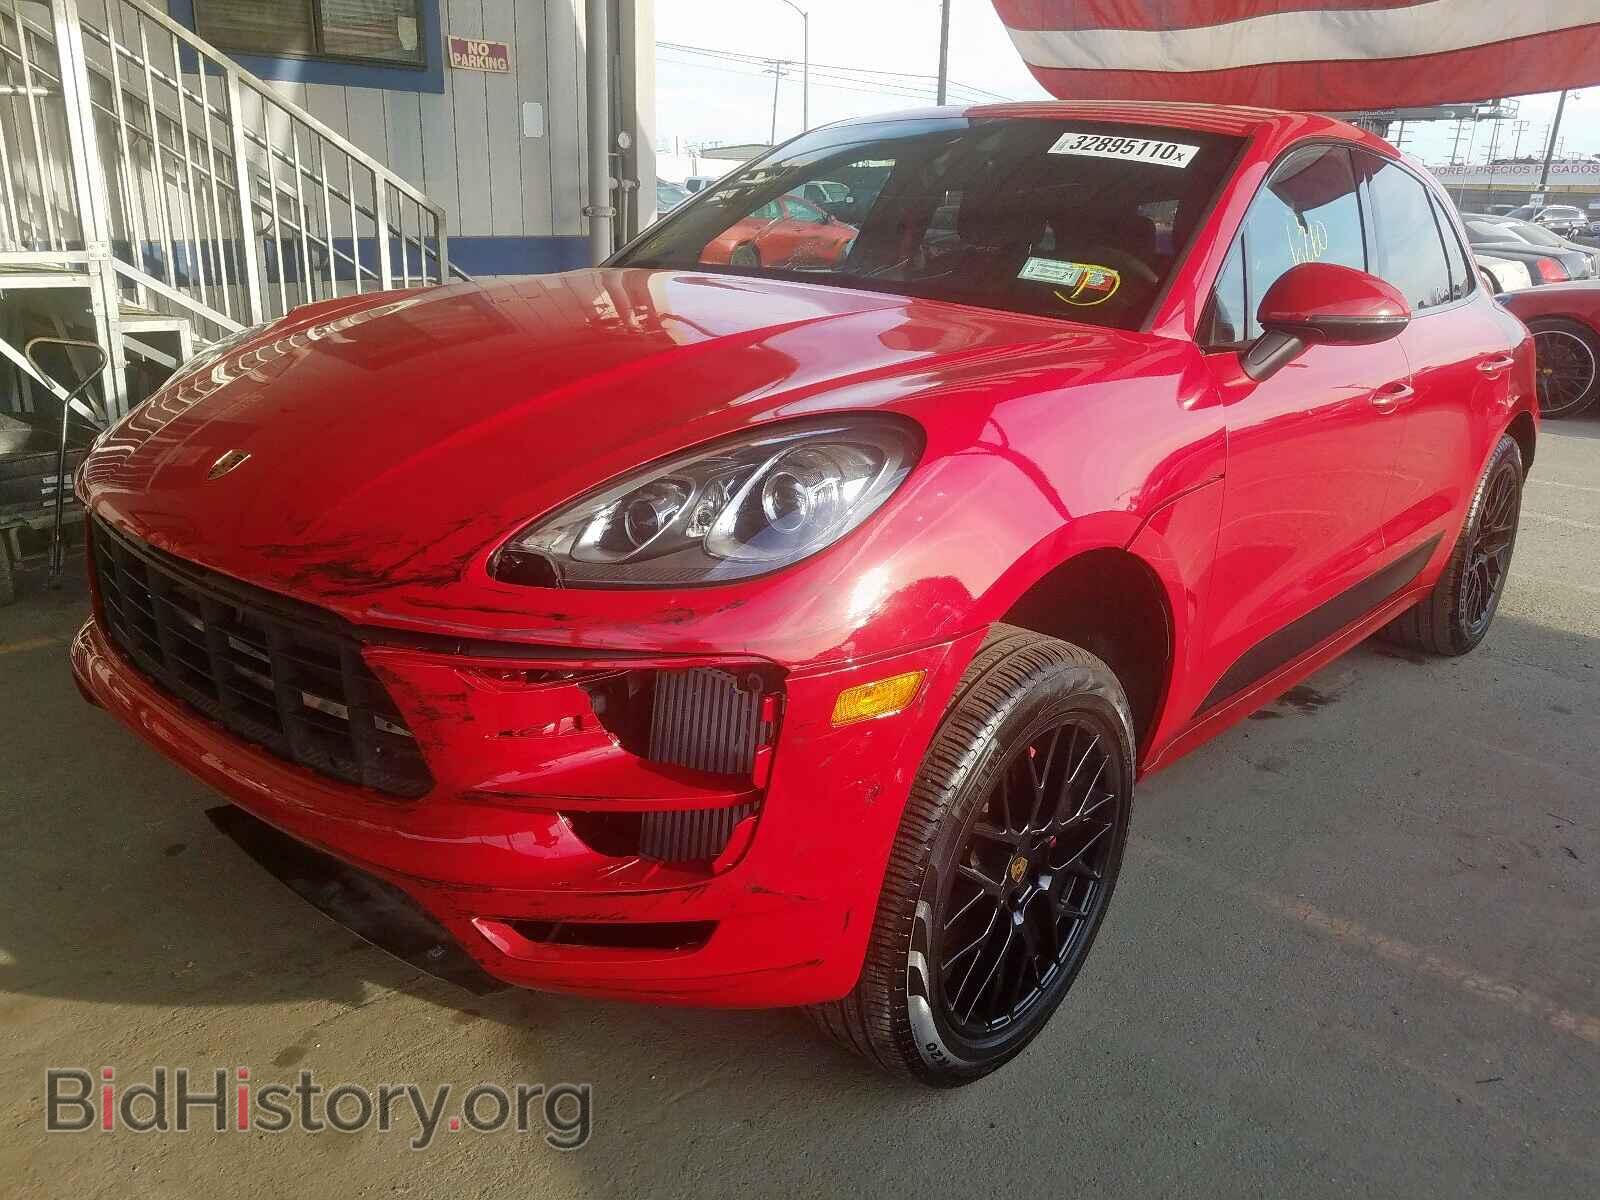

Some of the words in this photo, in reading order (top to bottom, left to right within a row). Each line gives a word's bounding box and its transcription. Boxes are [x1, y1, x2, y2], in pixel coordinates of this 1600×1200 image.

[467, 41, 490, 56] NO
[453, 52, 507, 70] PARKING
[1475, 165, 1531, 175] PRECIOS
[1534, 164, 1600, 174] PGADOS
